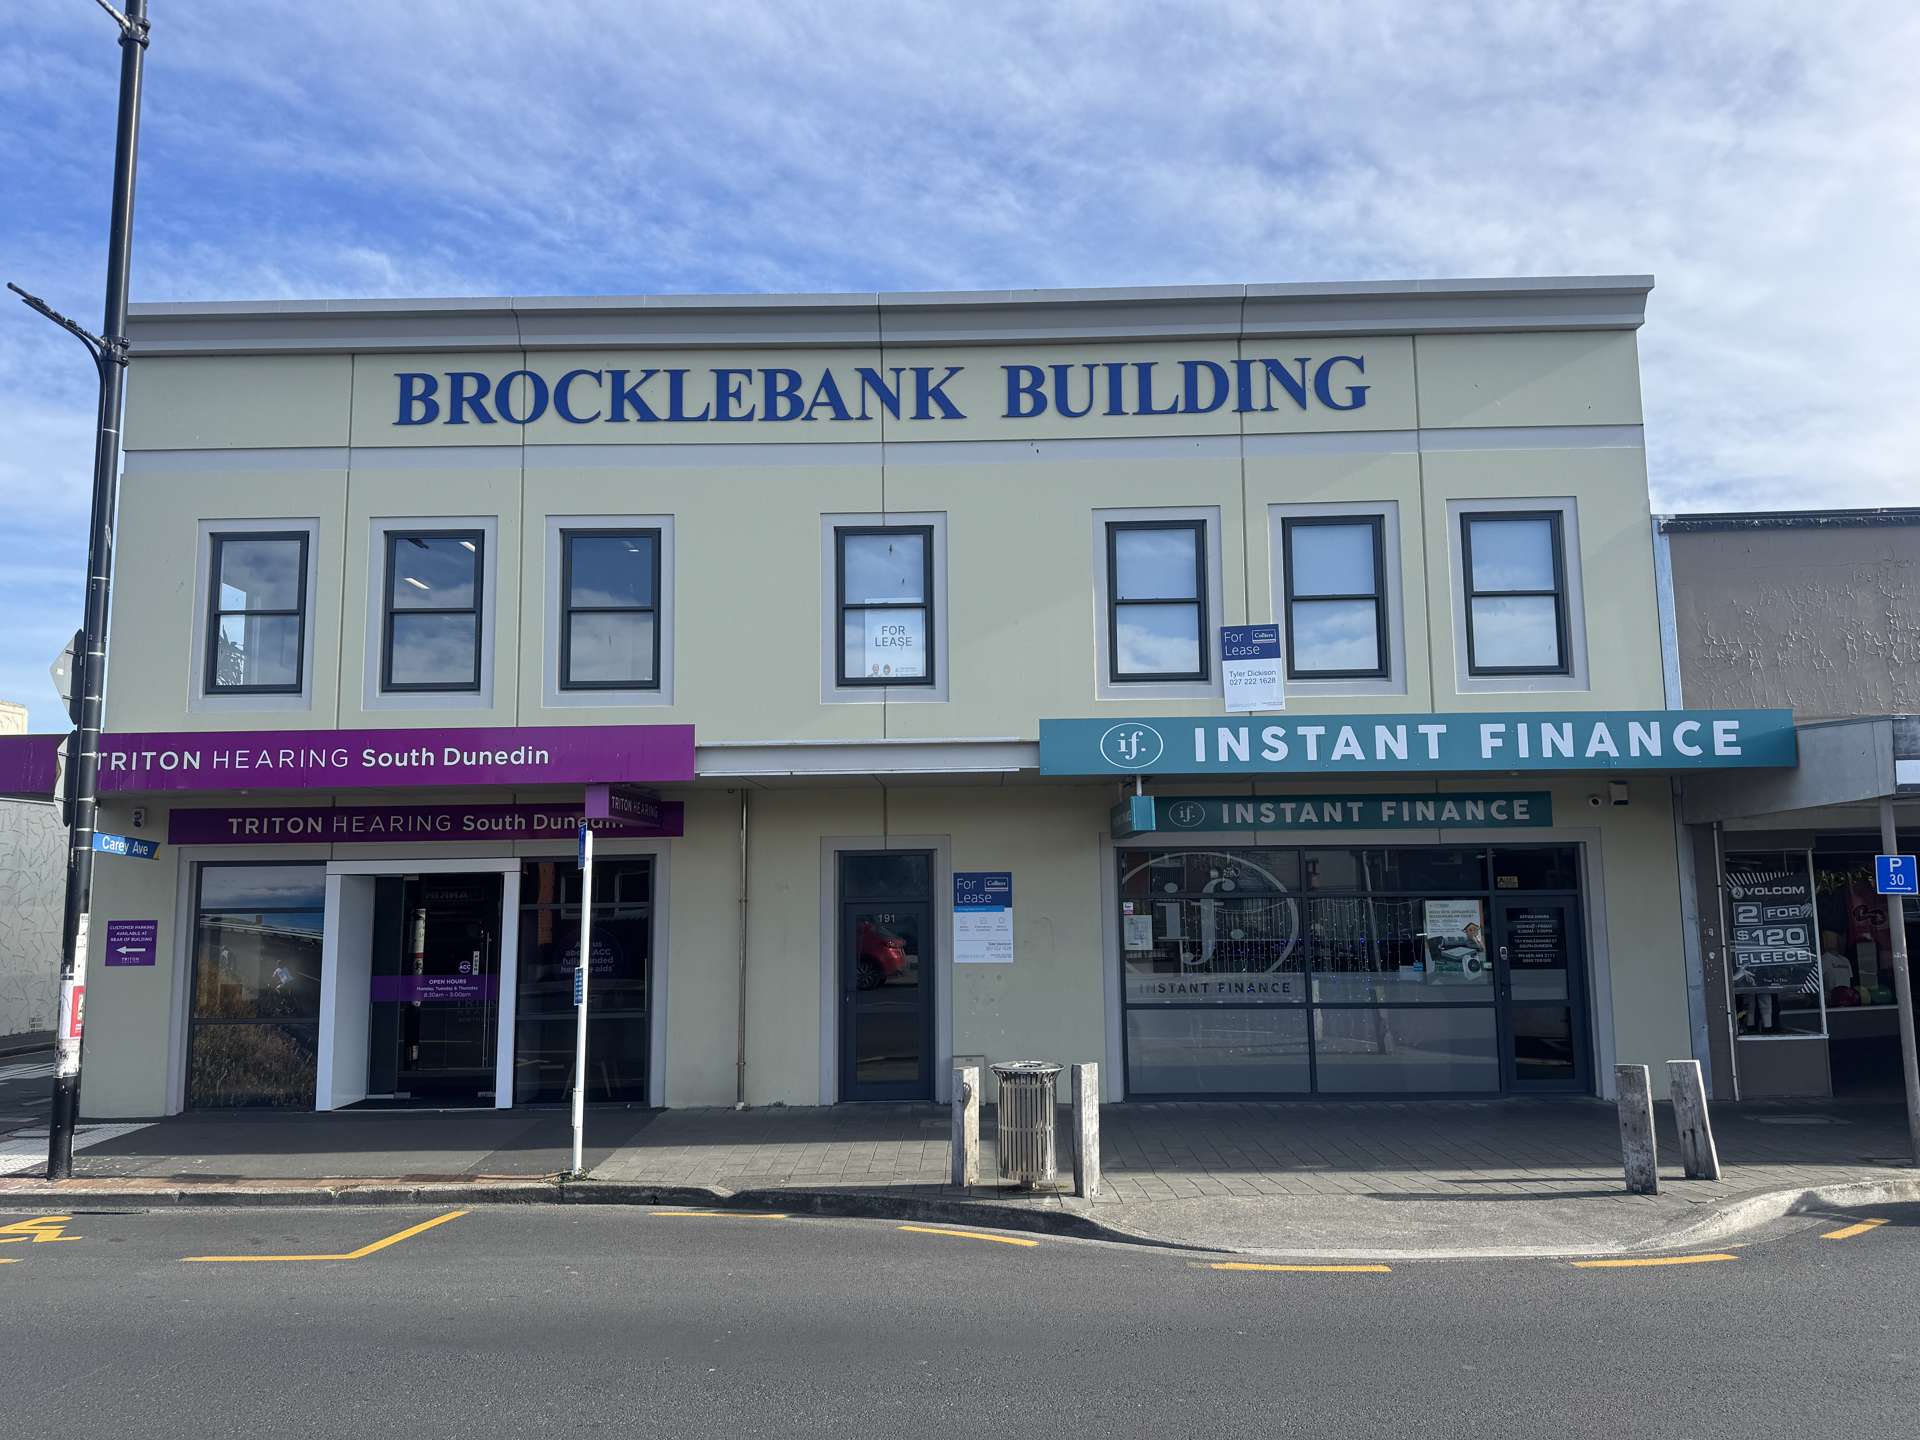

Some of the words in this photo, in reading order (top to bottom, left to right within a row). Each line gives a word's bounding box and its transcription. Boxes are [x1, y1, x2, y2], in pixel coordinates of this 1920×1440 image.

[392, 367, 967, 426] BROCKLEBANK
[1001, 355, 1372, 419] BUILDING
[881, 625, 906, 636] FOR
[874, 636, 913, 647] LEASE
[1224, 632, 1244, 643] For
[1225, 645, 1260, 656] Lease
[1194, 724, 1448, 762] INSTANT
[1480, 720, 1742, 760] FINANCE
[97, 751, 201, 771] TRITON
[213, 749, 349, 769] HEARING
[362, 747, 435, 767] South
[443, 746, 549, 766] Dunedin
[1222, 802, 1364, 824] INSTANT
[1382, 800, 1531, 823] FINANCE
[228, 817, 322, 834] TRITON
[333, 814, 452, 833] HEARING
[463, 813, 523, 831] South
[102, 836, 129, 855] Carey
[132, 841, 149, 855] Ave
[1890, 857, 1902, 873] P
[956, 878, 977, 890] For
[1889, 874, 1905, 886] 30
[1744, 886, 1805, 896] VOLCOM
[956, 893, 992, 904] Lease
[878, 913, 895, 923] 191
[1737, 906, 1759, 922] 2
[1767, 907, 1800, 918] FOR
[1736, 928, 1805, 946] $120
[1738, 950, 1809, 964] FLEECE
[1140, 982, 1209, 994] INSTANT
[1219, 982, 1291, 993] FINANCE
